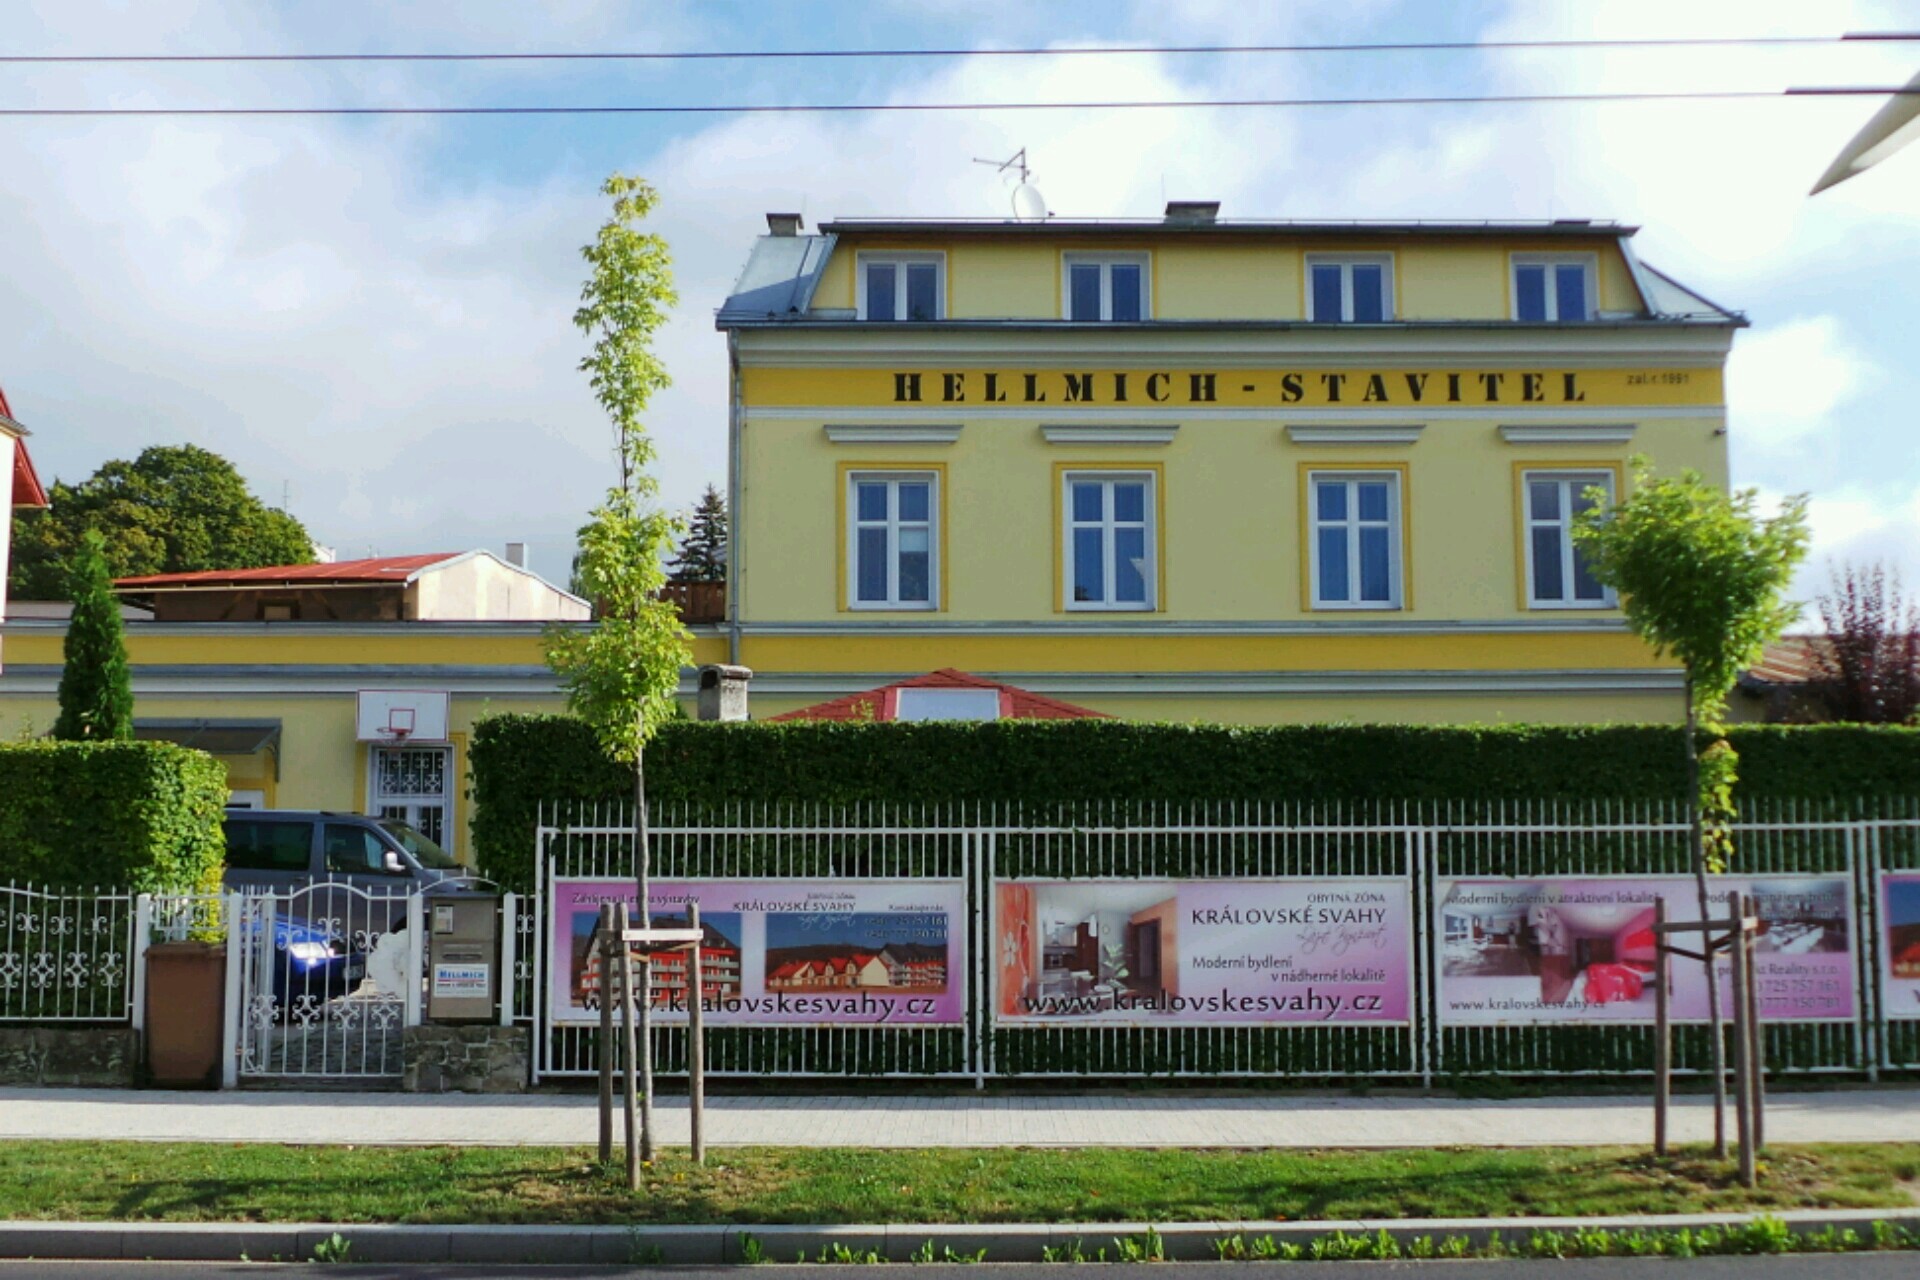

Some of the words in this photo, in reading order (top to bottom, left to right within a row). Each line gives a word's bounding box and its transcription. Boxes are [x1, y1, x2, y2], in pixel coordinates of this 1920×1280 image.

[894, 372, 1216, 402] HELLMICH
[1281, 372, 1586, 402] STAVITEL
[733, 898, 808, 912] KRÁLOVSKÉ
[812, 901, 856, 912] SVAHY
[1354, 892, 1386, 903] ZÓNA
[1192, 904, 1315, 925] KRÁLOVSKÉ
[1318, 908, 1387, 924] SVAHY
[1193, 955, 1245, 969] Moderní
[1248, 955, 1293, 972] bydlení
[1271, 973, 1279, 983] v
[1281, 968, 1338, 983] nádherné
[1341, 967, 1386, 983] lokalitě
[1022, 987, 1383, 1021] www.kralovskesvahy.cz
